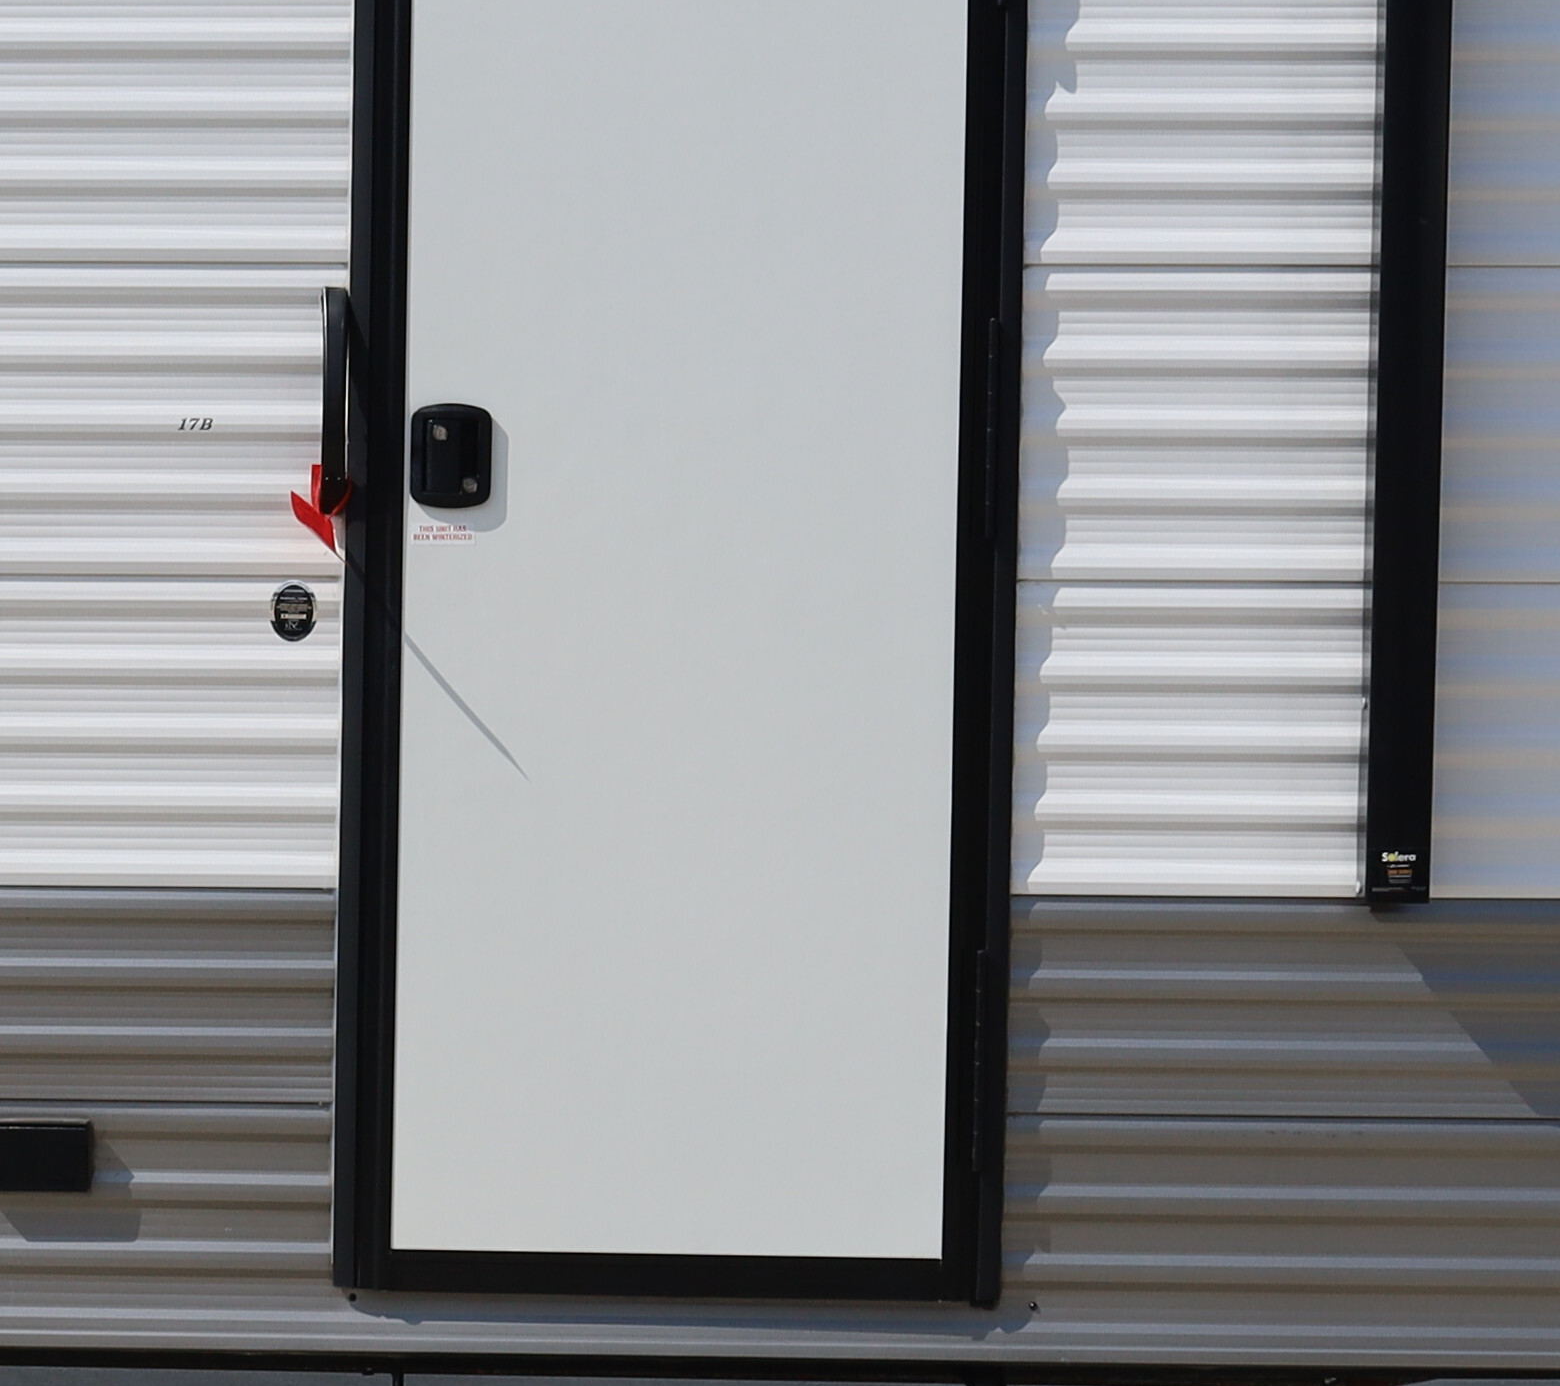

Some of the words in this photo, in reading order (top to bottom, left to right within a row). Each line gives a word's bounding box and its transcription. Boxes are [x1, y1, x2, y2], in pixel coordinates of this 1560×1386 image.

[178, 417, 214, 431] 17B
[419, 525, 434, 533] THIS
[436, 525, 452, 533] UNIT
[453, 525, 468, 533] HAS
[413, 533, 431, 541] BEEN
[432, 533, 473, 541] WINTERIZED
[1381, 850, 1417, 862] Solera
